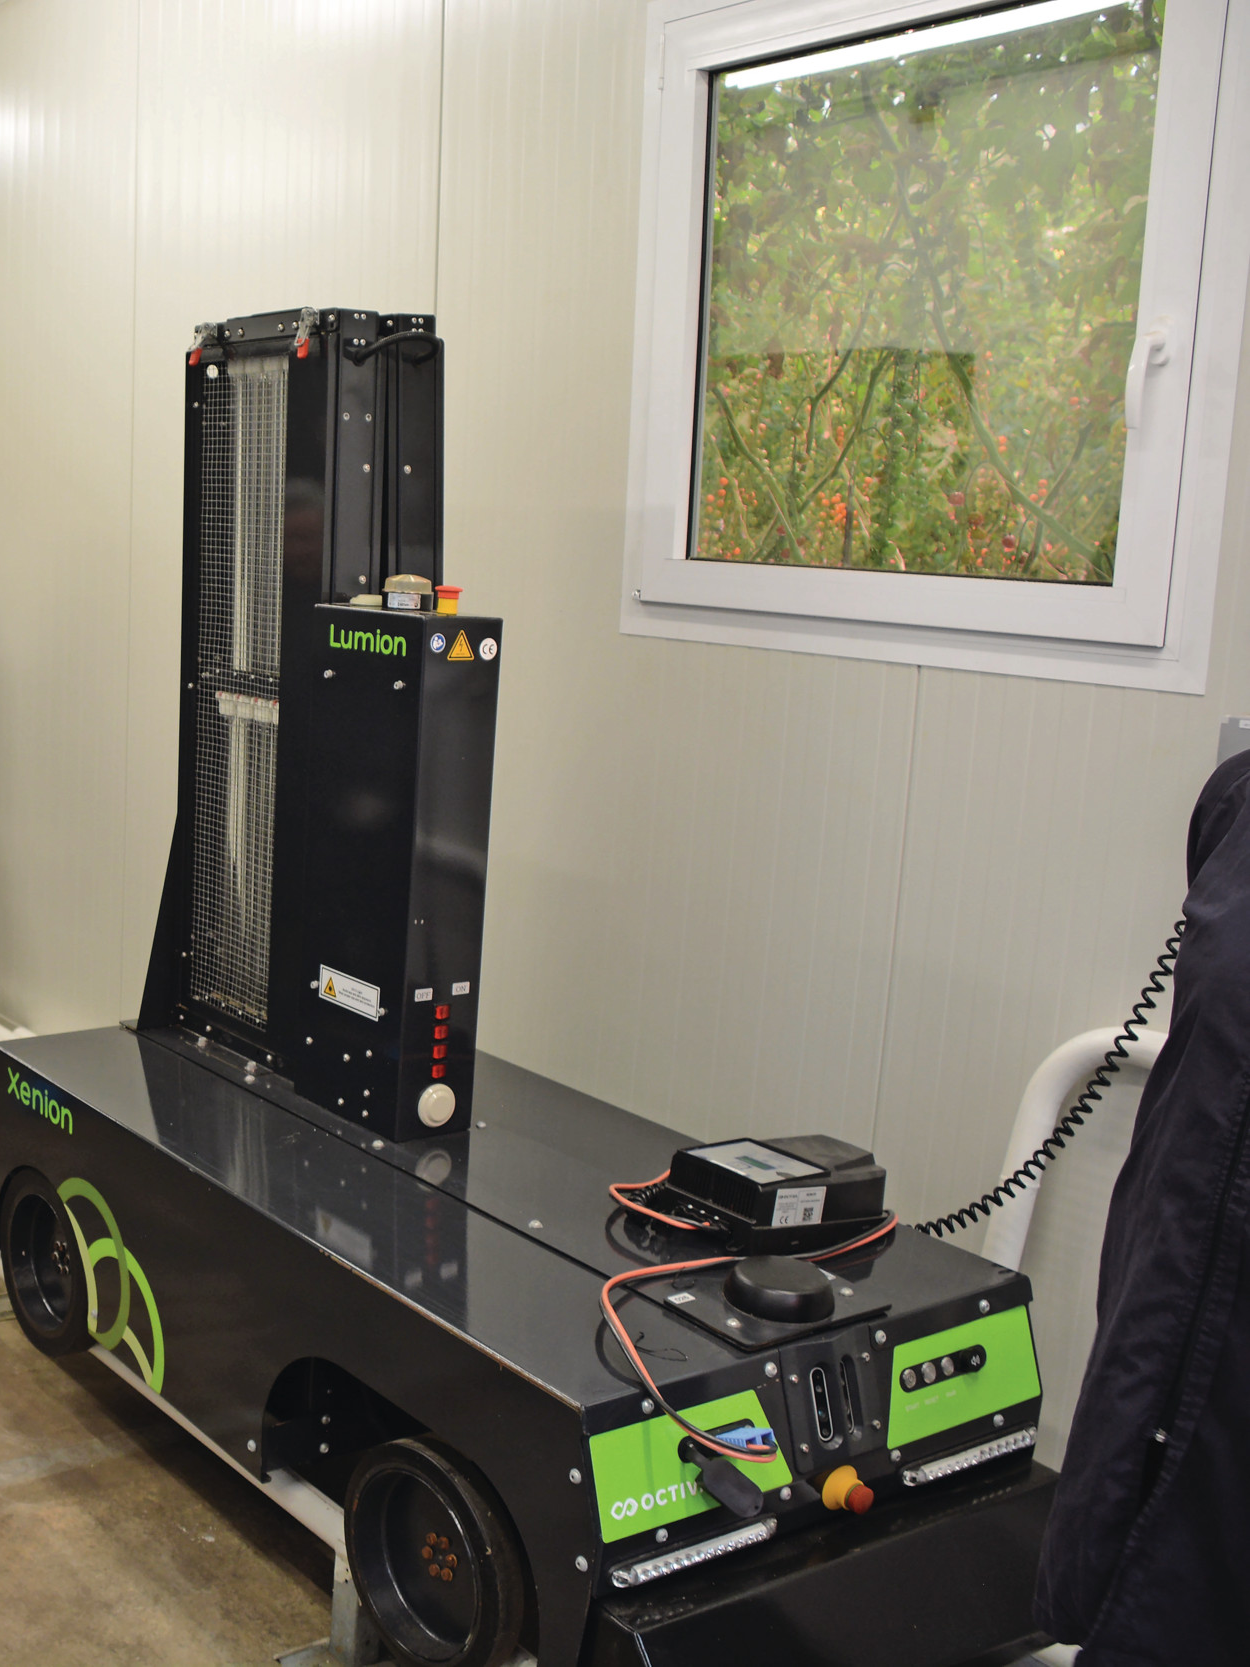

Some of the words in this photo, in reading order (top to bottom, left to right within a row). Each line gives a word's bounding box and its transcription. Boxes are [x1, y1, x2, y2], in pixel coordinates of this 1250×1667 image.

[329, 623, 407, 657] Lumion
[416, 991, 431, 1000] OFF
[455, 984, 467, 993] ON
[7, 1066, 74, 1136] Xenion
[640, 1481, 704, 1511] OCTIV
